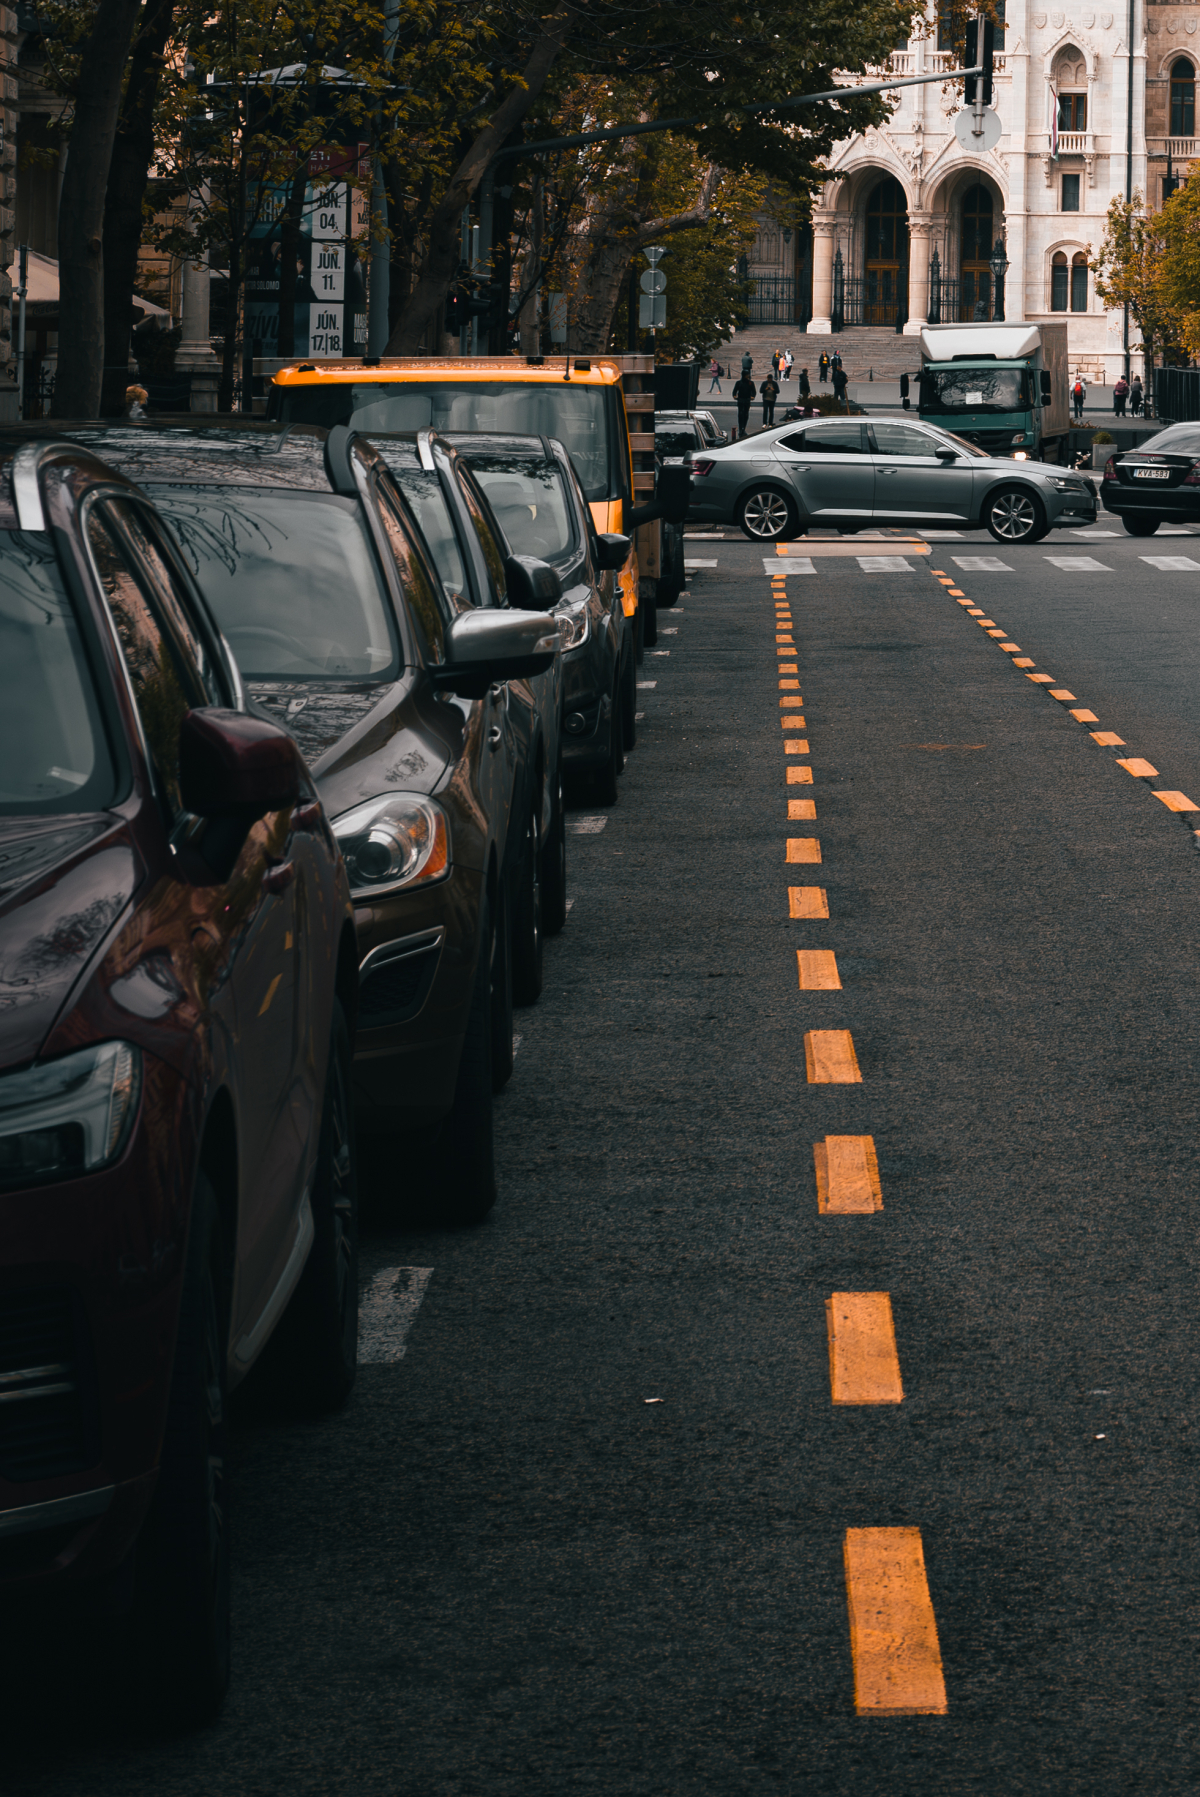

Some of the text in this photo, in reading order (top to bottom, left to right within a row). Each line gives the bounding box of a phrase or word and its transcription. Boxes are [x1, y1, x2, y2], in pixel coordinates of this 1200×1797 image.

[320, 213, 338, 229] 04.
[322, 274, 336, 290] 11.
[316, 310, 339, 330] JÚN.
